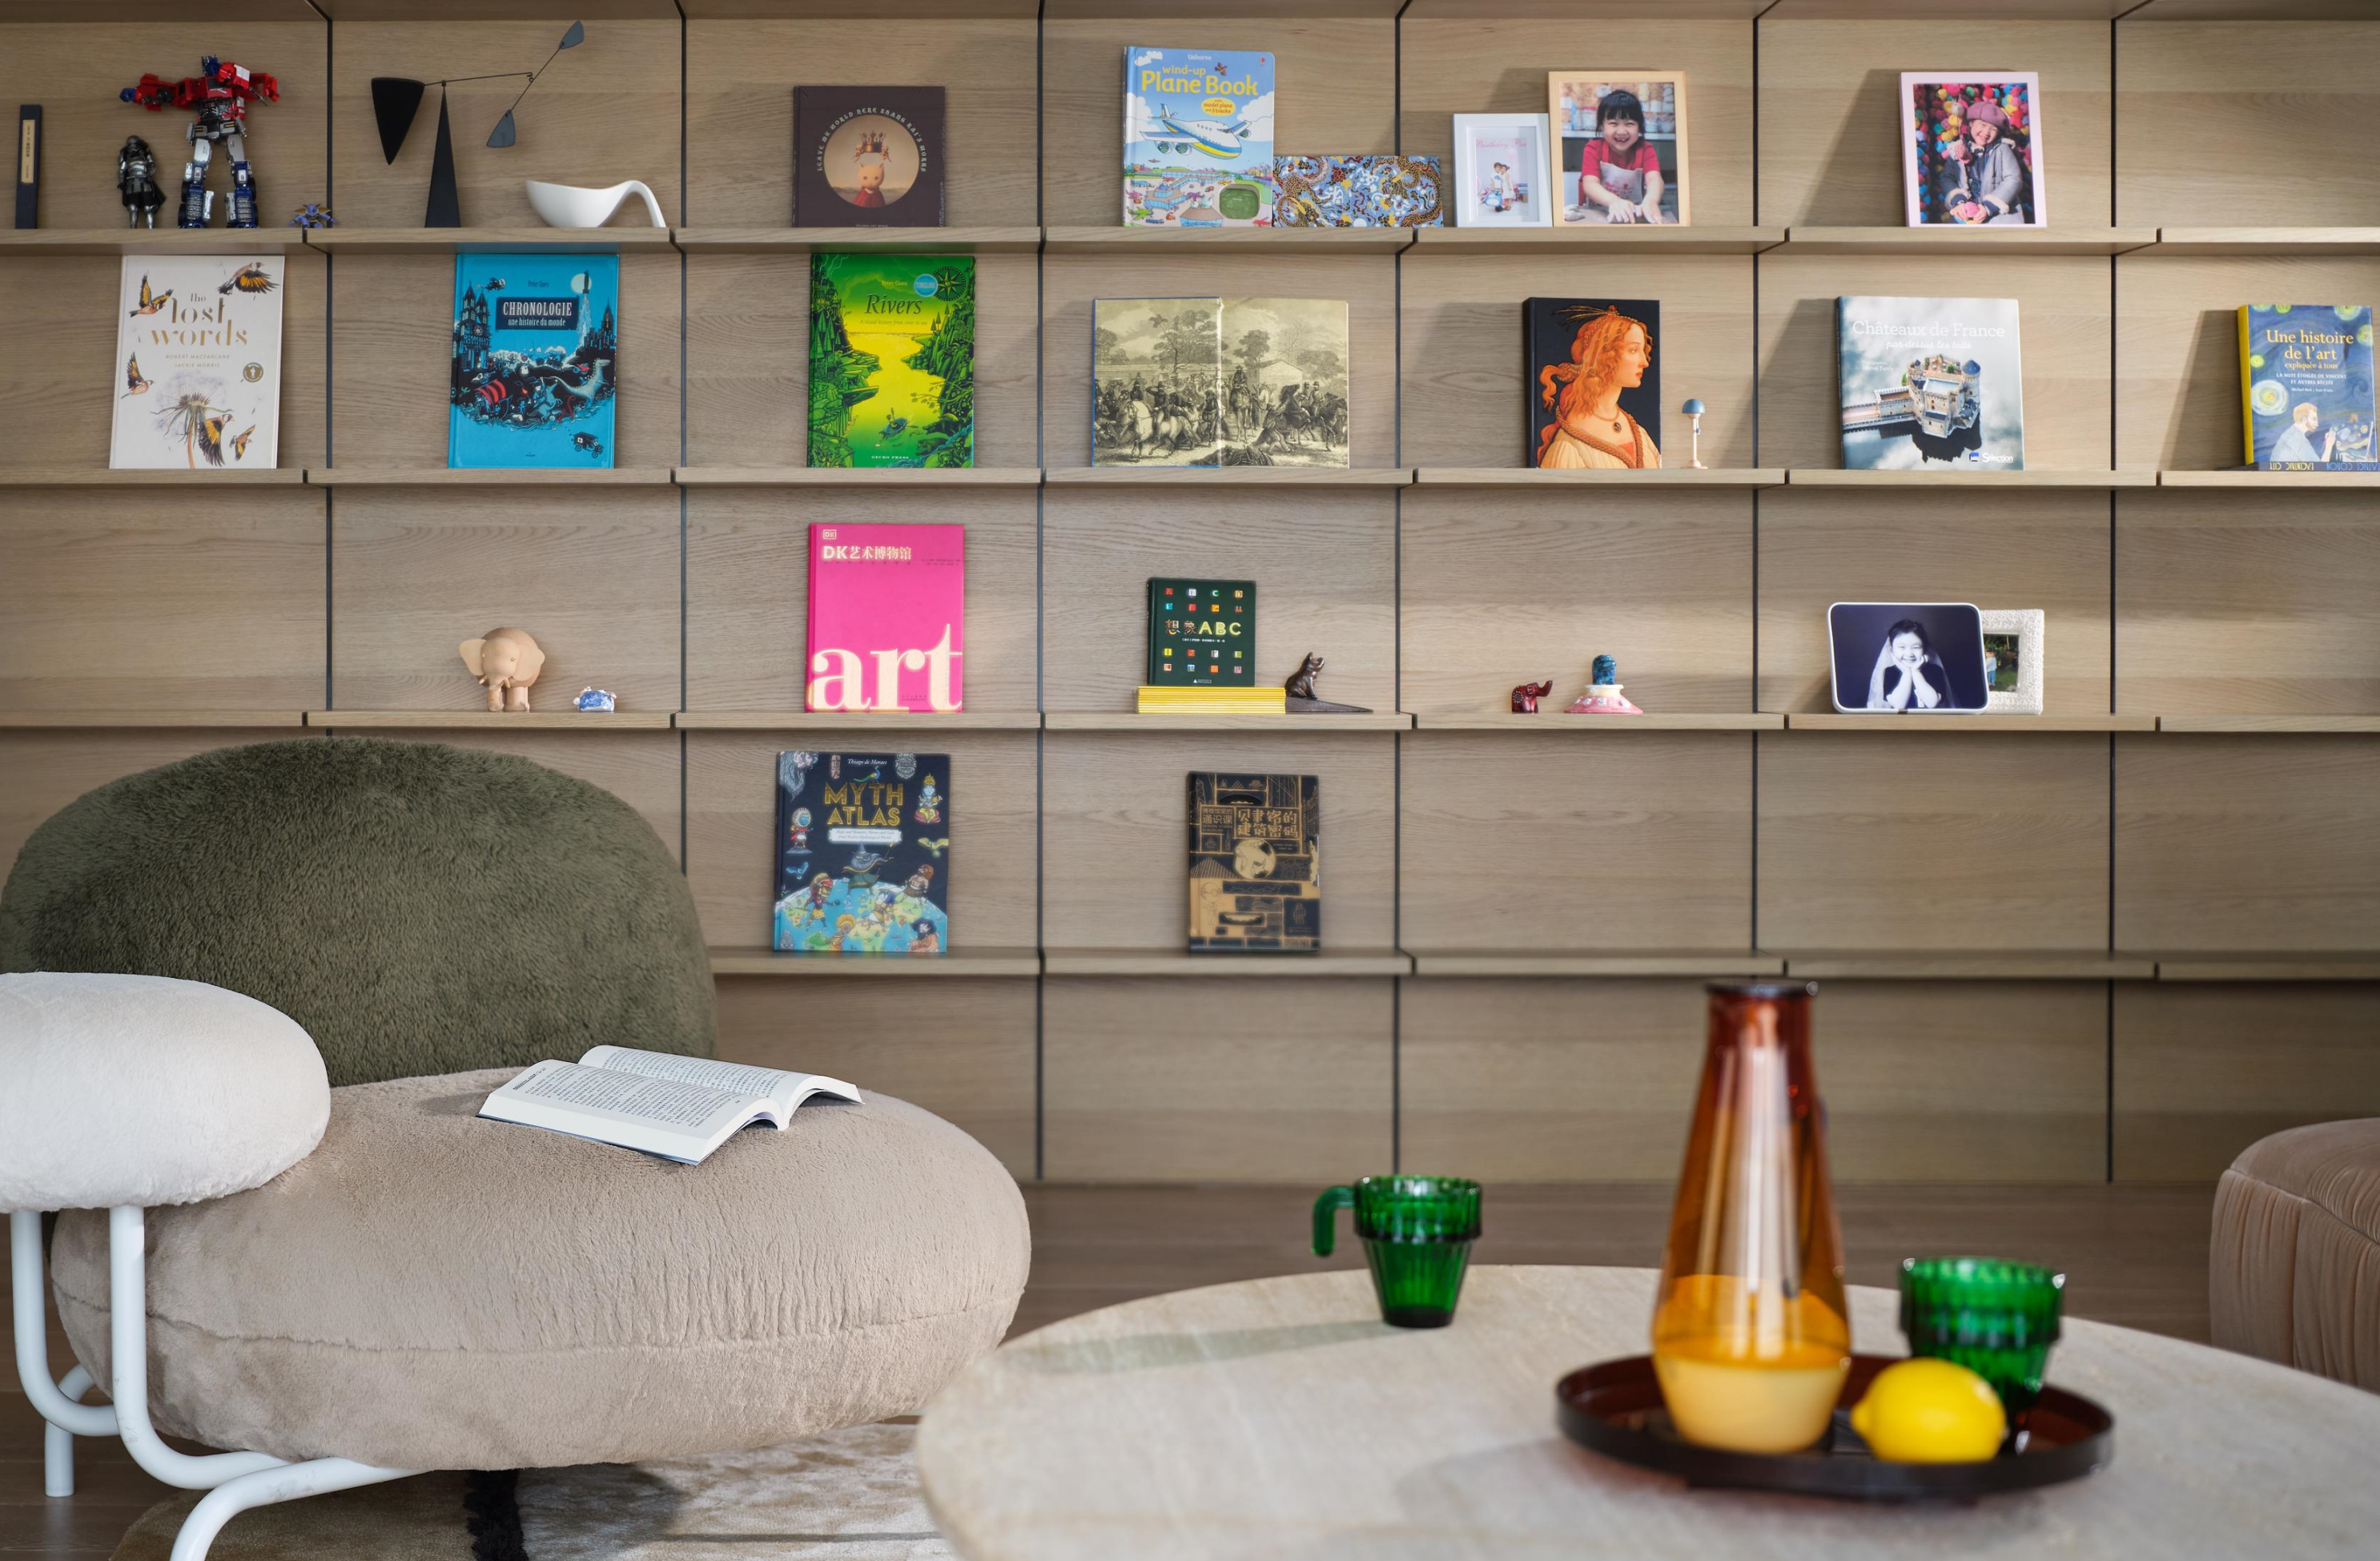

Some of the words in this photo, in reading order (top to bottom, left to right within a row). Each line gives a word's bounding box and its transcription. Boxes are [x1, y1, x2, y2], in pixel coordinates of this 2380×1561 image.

[1162, 64, 1206, 78] wind-up
[1141, 70, 1201, 94] Plane
[1205, 74, 1258, 96] Book
[191, 292, 207, 303] the
[864, 293, 923, 315] Rivers
[171, 297, 225, 324] lost
[503, 301, 573, 316] CHRONOLOGIE
[519, 318, 539, 326] histoire
[541, 318, 548, 326] du
[549, 318, 566, 327] monde
[1852, 320, 1926, 336] Châteaux
[1930, 321, 1948, 336] de
[1952, 322, 2005, 337] France
[151, 320, 247, 346] words
[2266, 329, 2296, 343] Une
[2300, 329, 2354, 344] histoire
[1886, 340, 1935, 350] par-dessus
[1936, 340, 1951, 348] les
[1952, 341, 1972, 349] toits
[2284, 345, 2302, 360] de
[2306, 346, 2337, 360] l’art
[2285, 361, 2317, 370] expliquée
[822, 545, 912, 561] DK艺术博物馆
[808, 623, 963, 711] art
[825, 782, 903, 806] MYTH
[827, 807, 900, 827] ATLAS
[1203, 814, 1232, 824] 通识课
[1237, 822, 1297, 838] 建筑密码
